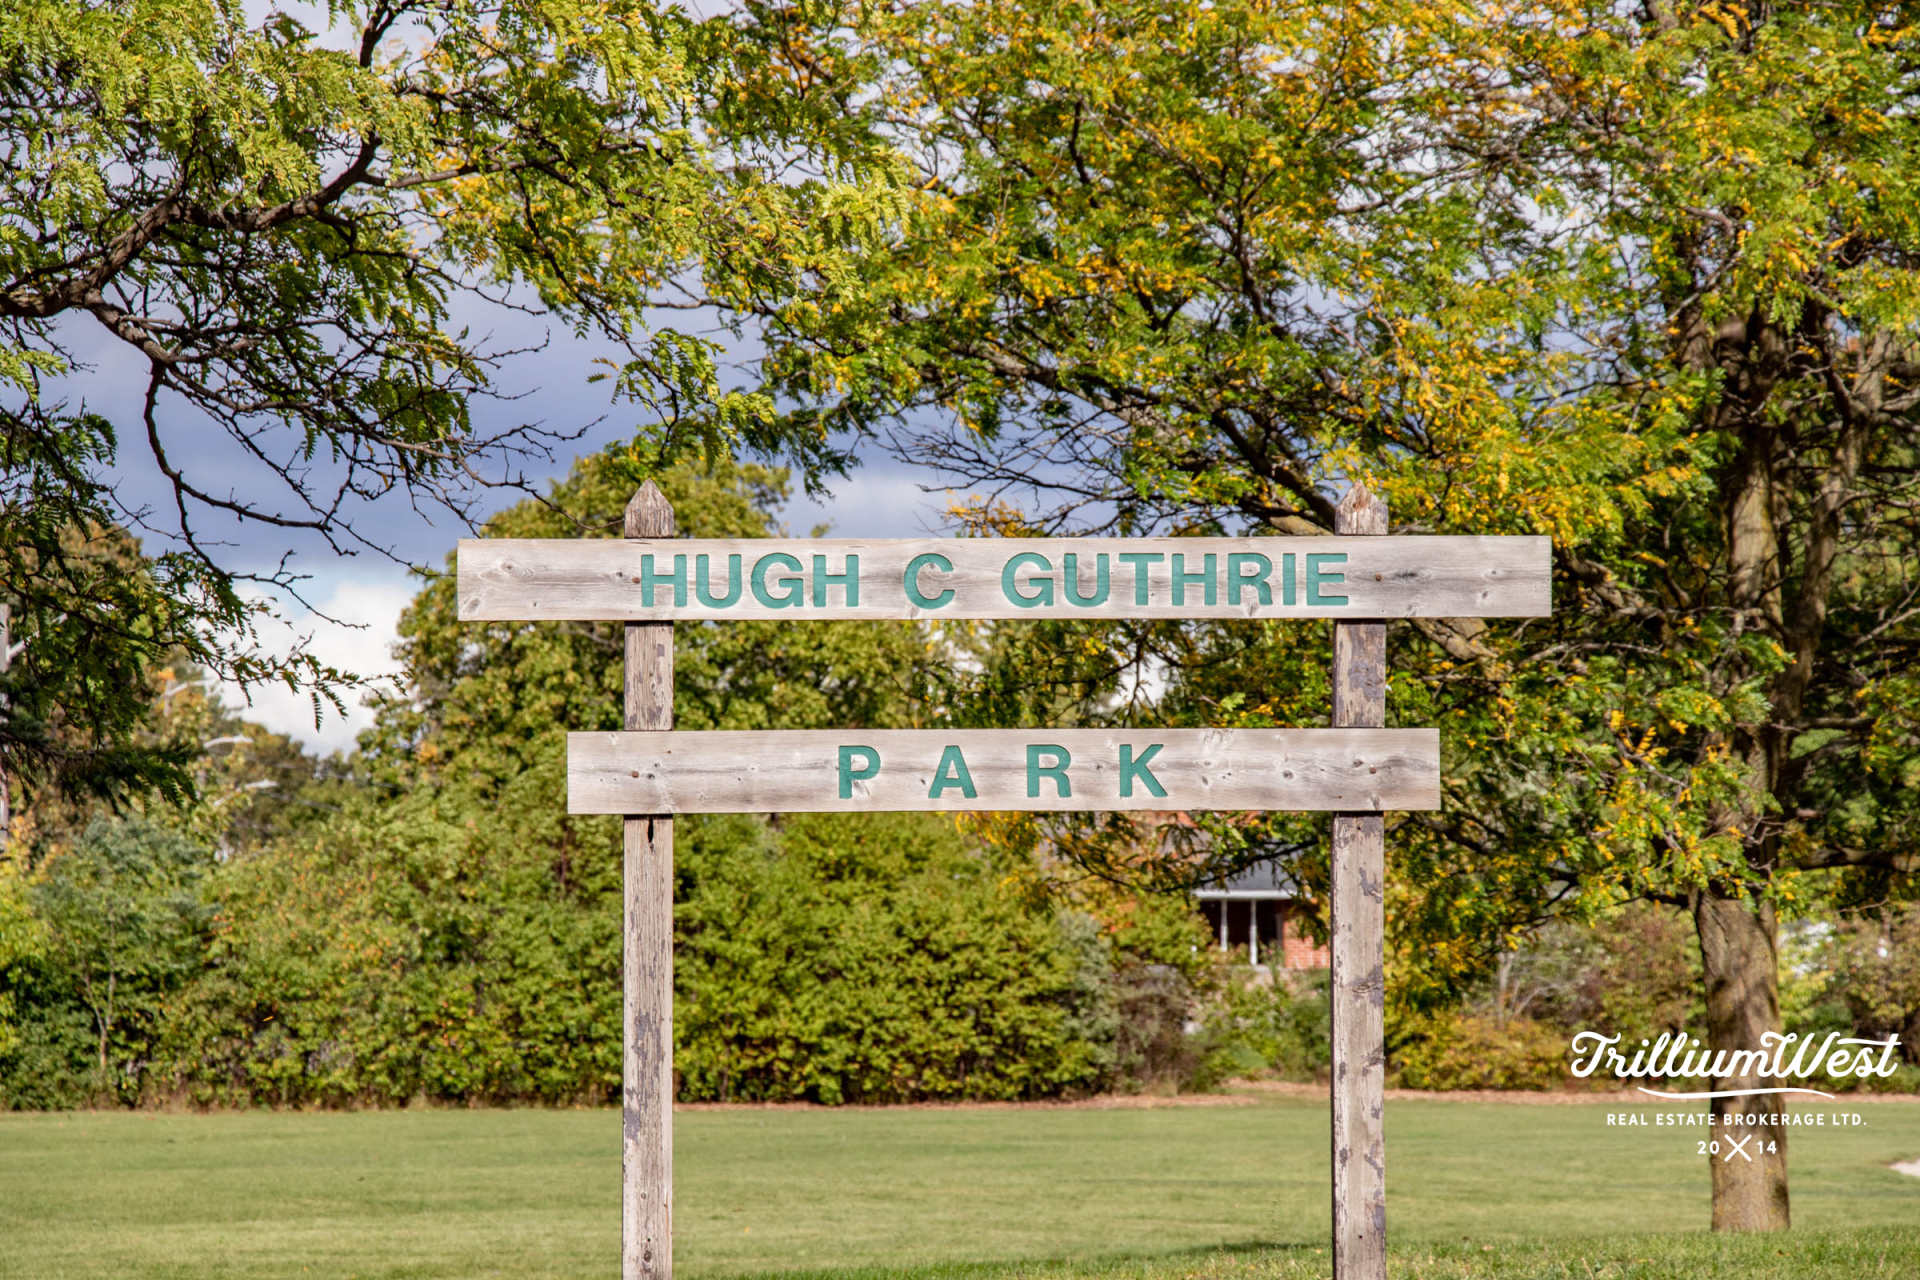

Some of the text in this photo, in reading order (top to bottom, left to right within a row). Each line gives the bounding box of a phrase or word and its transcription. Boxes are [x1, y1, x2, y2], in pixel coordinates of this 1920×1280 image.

[640, 552, 1349, 609] HUGH C GUTHRIE
[838, 744, 1168, 799] PARK
